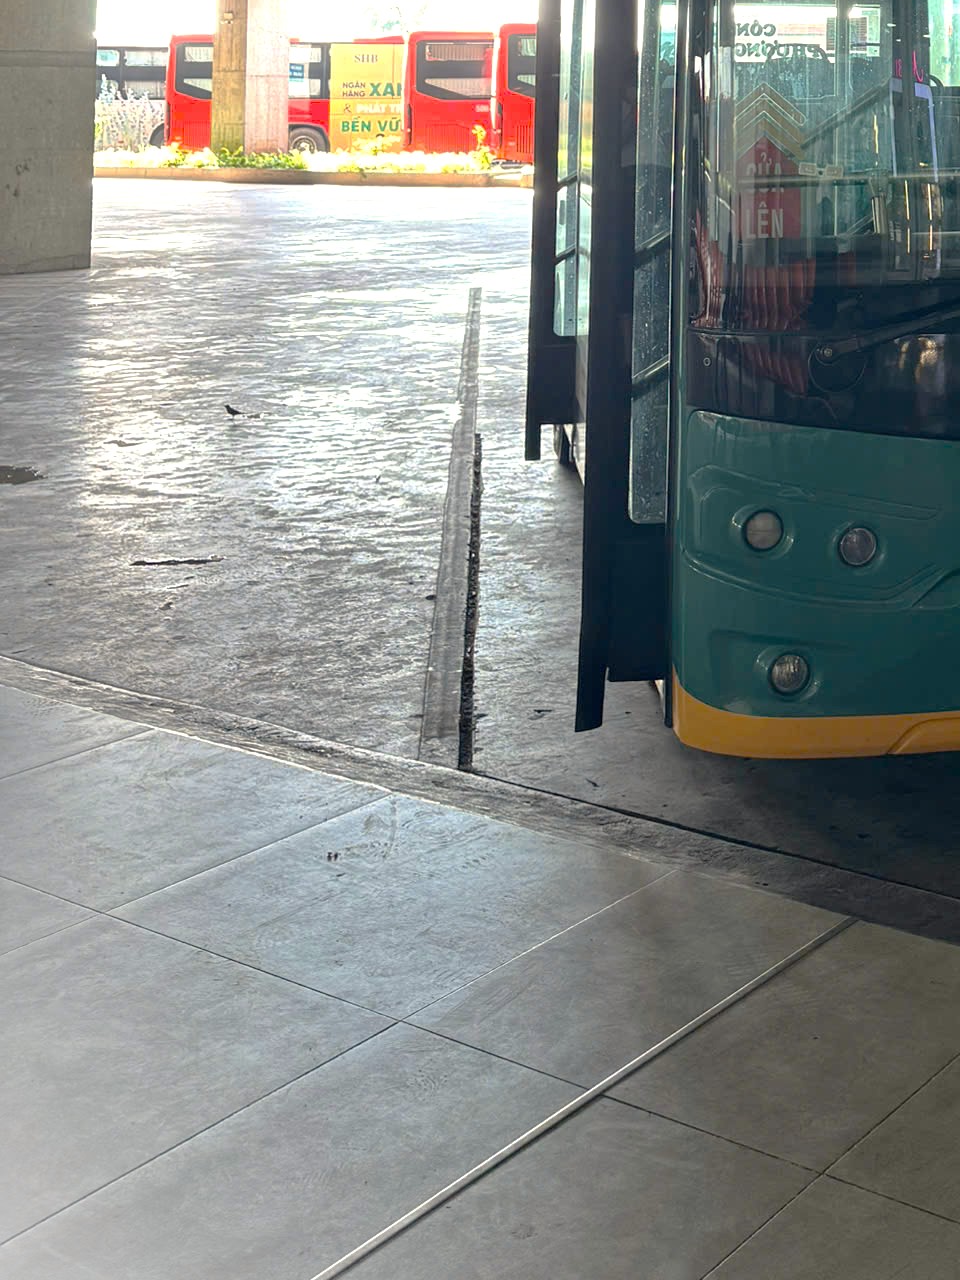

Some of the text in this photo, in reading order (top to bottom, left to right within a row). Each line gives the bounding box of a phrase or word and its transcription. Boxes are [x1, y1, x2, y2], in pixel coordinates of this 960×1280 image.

[354, 53, 378, 63] SHB
[342, 80, 366, 89] NGÂN
[745, 201, 785, 239] LÊN
